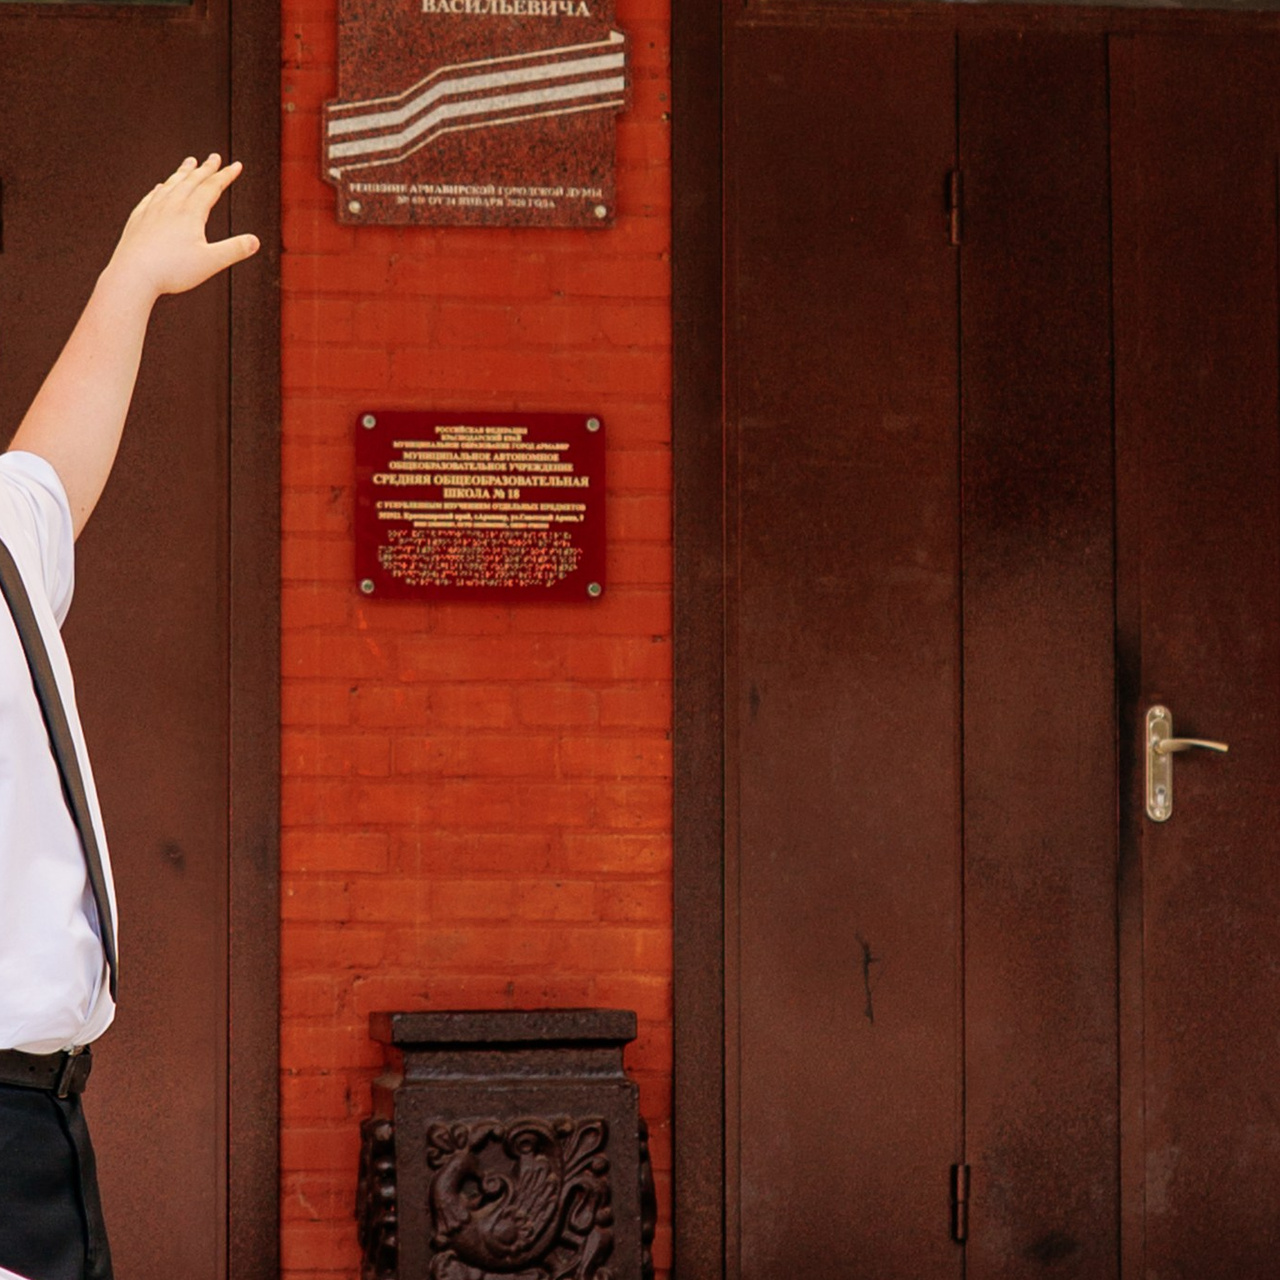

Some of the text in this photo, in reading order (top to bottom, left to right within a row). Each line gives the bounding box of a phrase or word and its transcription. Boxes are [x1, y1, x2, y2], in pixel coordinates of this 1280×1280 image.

[373, 474, 590, 488] СРЕДНЯЯ ОБЩЕОБРАЗОВАТЕЛЬНАЯ
[443, 488, 491, 500] ШКОЛА
